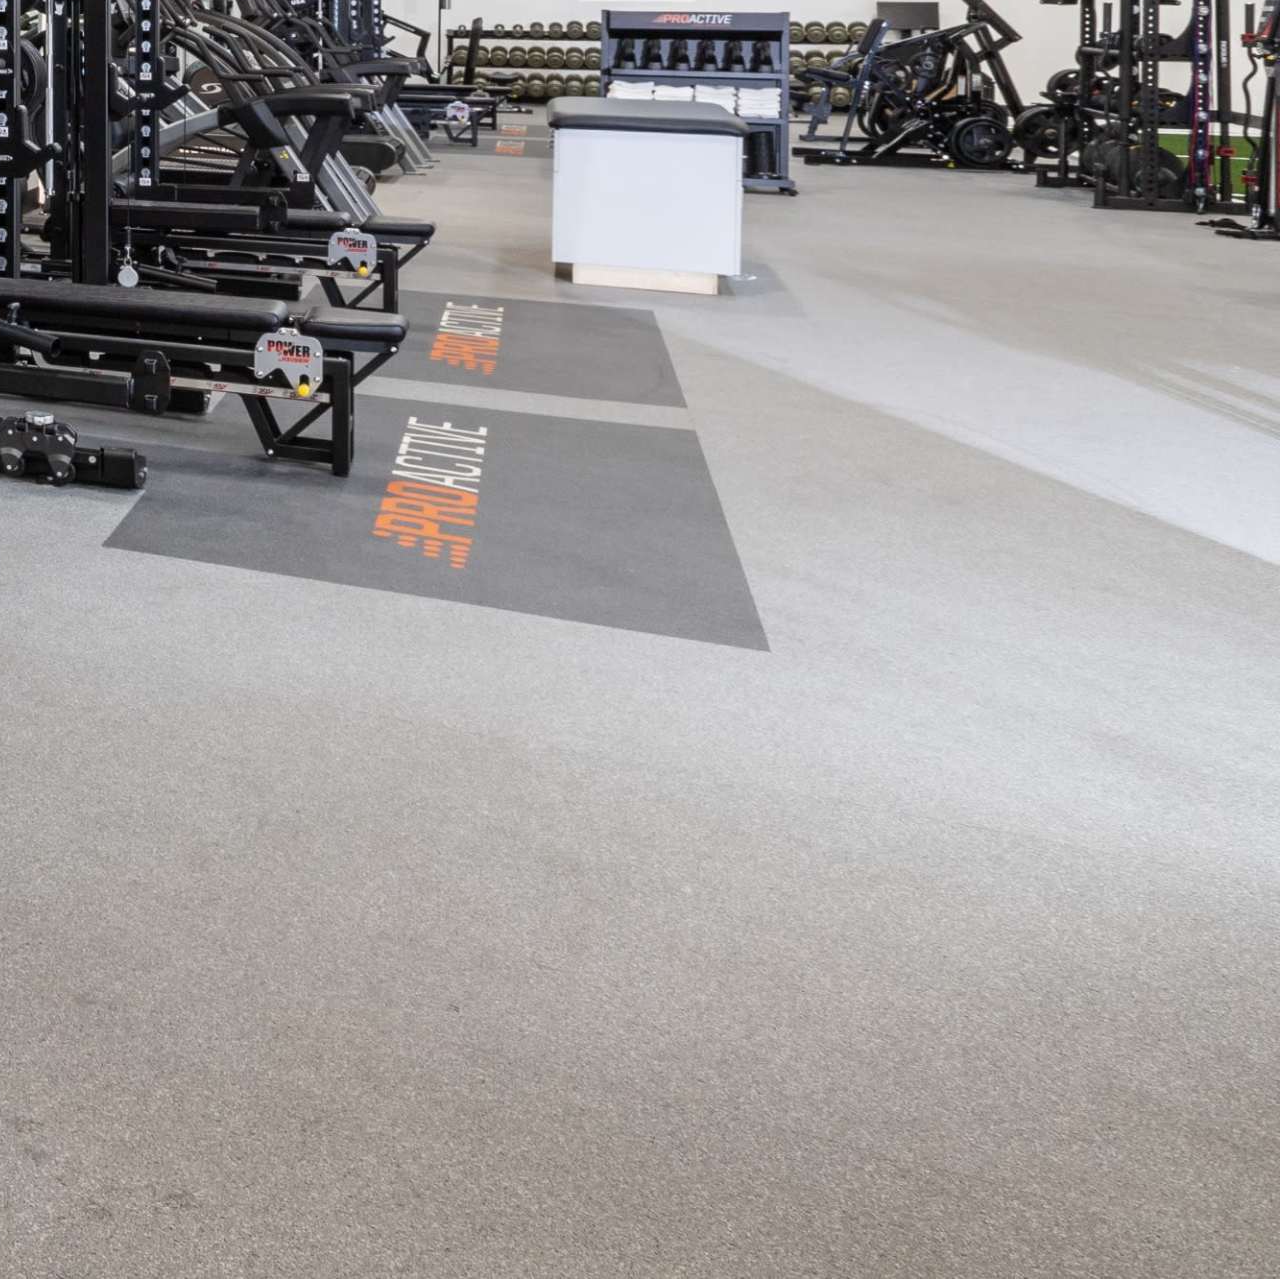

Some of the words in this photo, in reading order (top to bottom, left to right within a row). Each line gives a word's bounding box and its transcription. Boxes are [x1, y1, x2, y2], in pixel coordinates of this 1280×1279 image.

[663, 13, 733, 25] PROACTIVE
[266, 340, 310, 358] POWER
[374, 416, 488, 546] PROACTIVE
